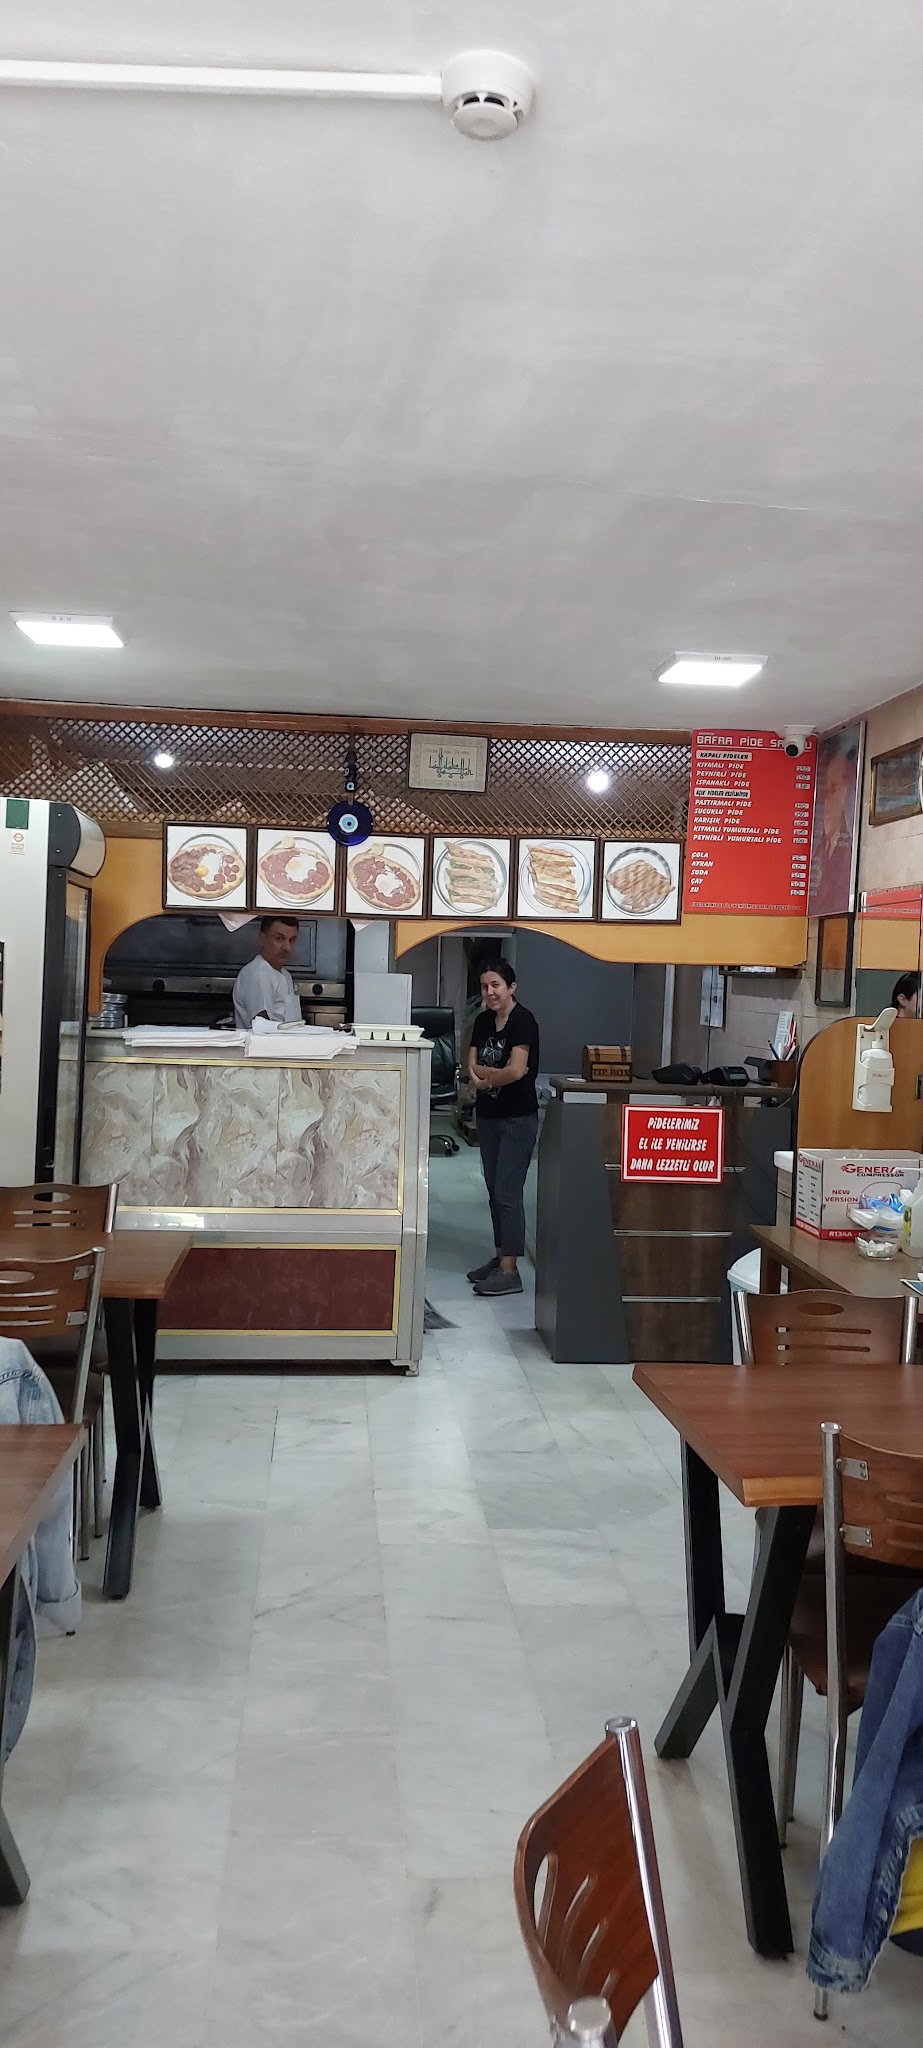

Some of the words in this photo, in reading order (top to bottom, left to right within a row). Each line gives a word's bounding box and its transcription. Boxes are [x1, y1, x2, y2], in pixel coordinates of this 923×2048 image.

[697, 735, 732, 745] BAFRA
[740, 736, 763, 747] PİDE
[728, 762, 744, 770] PİDE
[696, 770, 728, 778] PEYNİRLİ
[731, 771, 747, 779] PİDE
[693, 807, 724, 815] SUCUKLU
[727, 808, 744, 816] PİDE
[693, 816, 721, 824] KARIŞIK
[724, 817, 741, 825] PİDE
[722, 826, 760, 834] YUMURTALI
[763, 827, 780, 835] PİDE
[727, 835, 765, 843] YUMURTALI
[765, 836, 782, 844] PİDE
[690, 877, 704, 885] ÇAY
[647, 1117, 700, 1130] PİDELERİMİZ
[639, 1136, 649, 1150] EL
[651, 1137, 664, 1150] İLE
[665, 1138, 708, 1151] YENİLİRSE
[630, 1157, 654, 1170] DAHA
[656, 1158, 691, 1172] LEZZETLİ
[693, 1159, 715, 1172] OLUR
